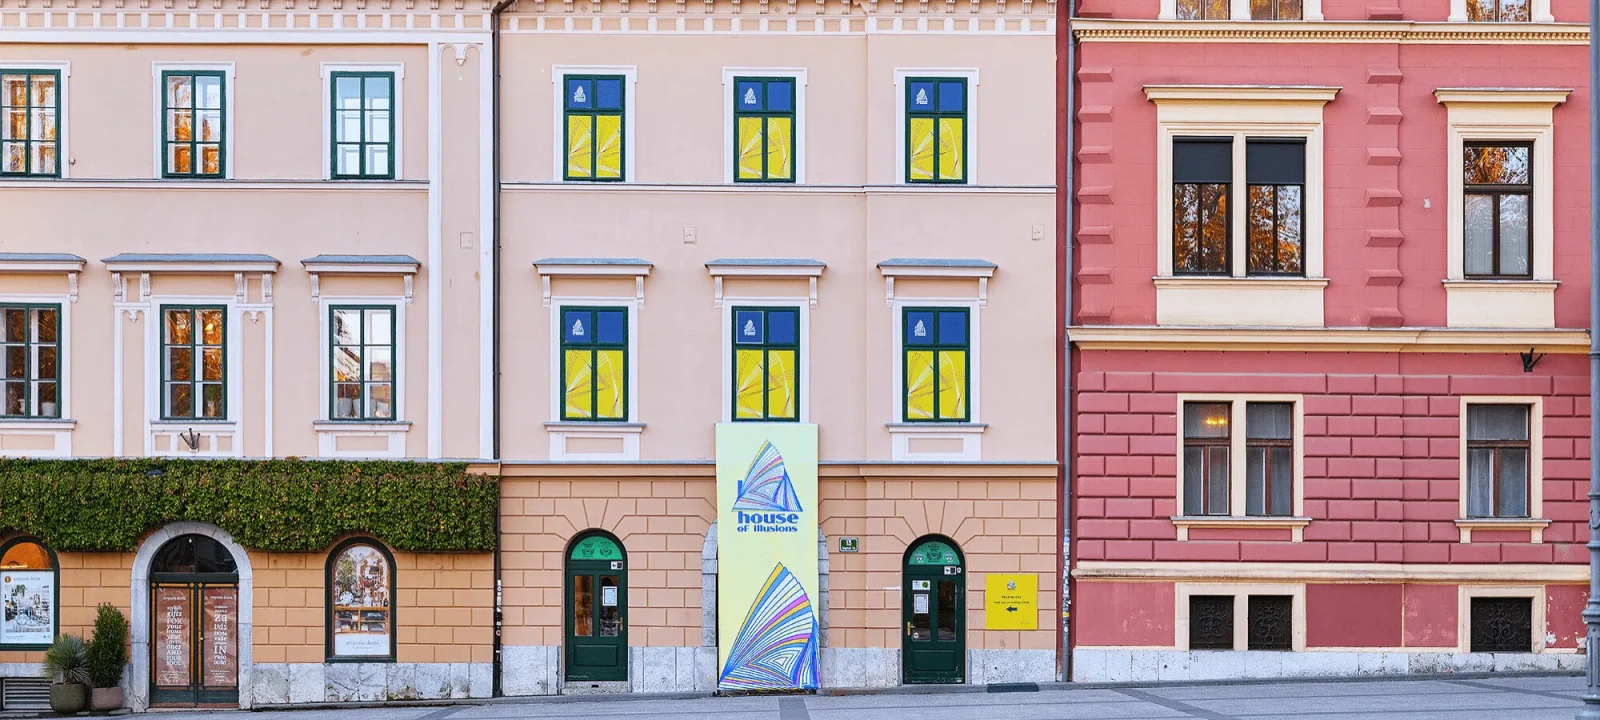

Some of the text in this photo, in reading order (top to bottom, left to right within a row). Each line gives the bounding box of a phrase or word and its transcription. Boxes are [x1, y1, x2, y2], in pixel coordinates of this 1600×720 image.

[737, 511, 799, 524] house
[753, 524, 798, 532] illusions
[214, 614, 228, 622] za
[214, 646, 227, 654] IN
